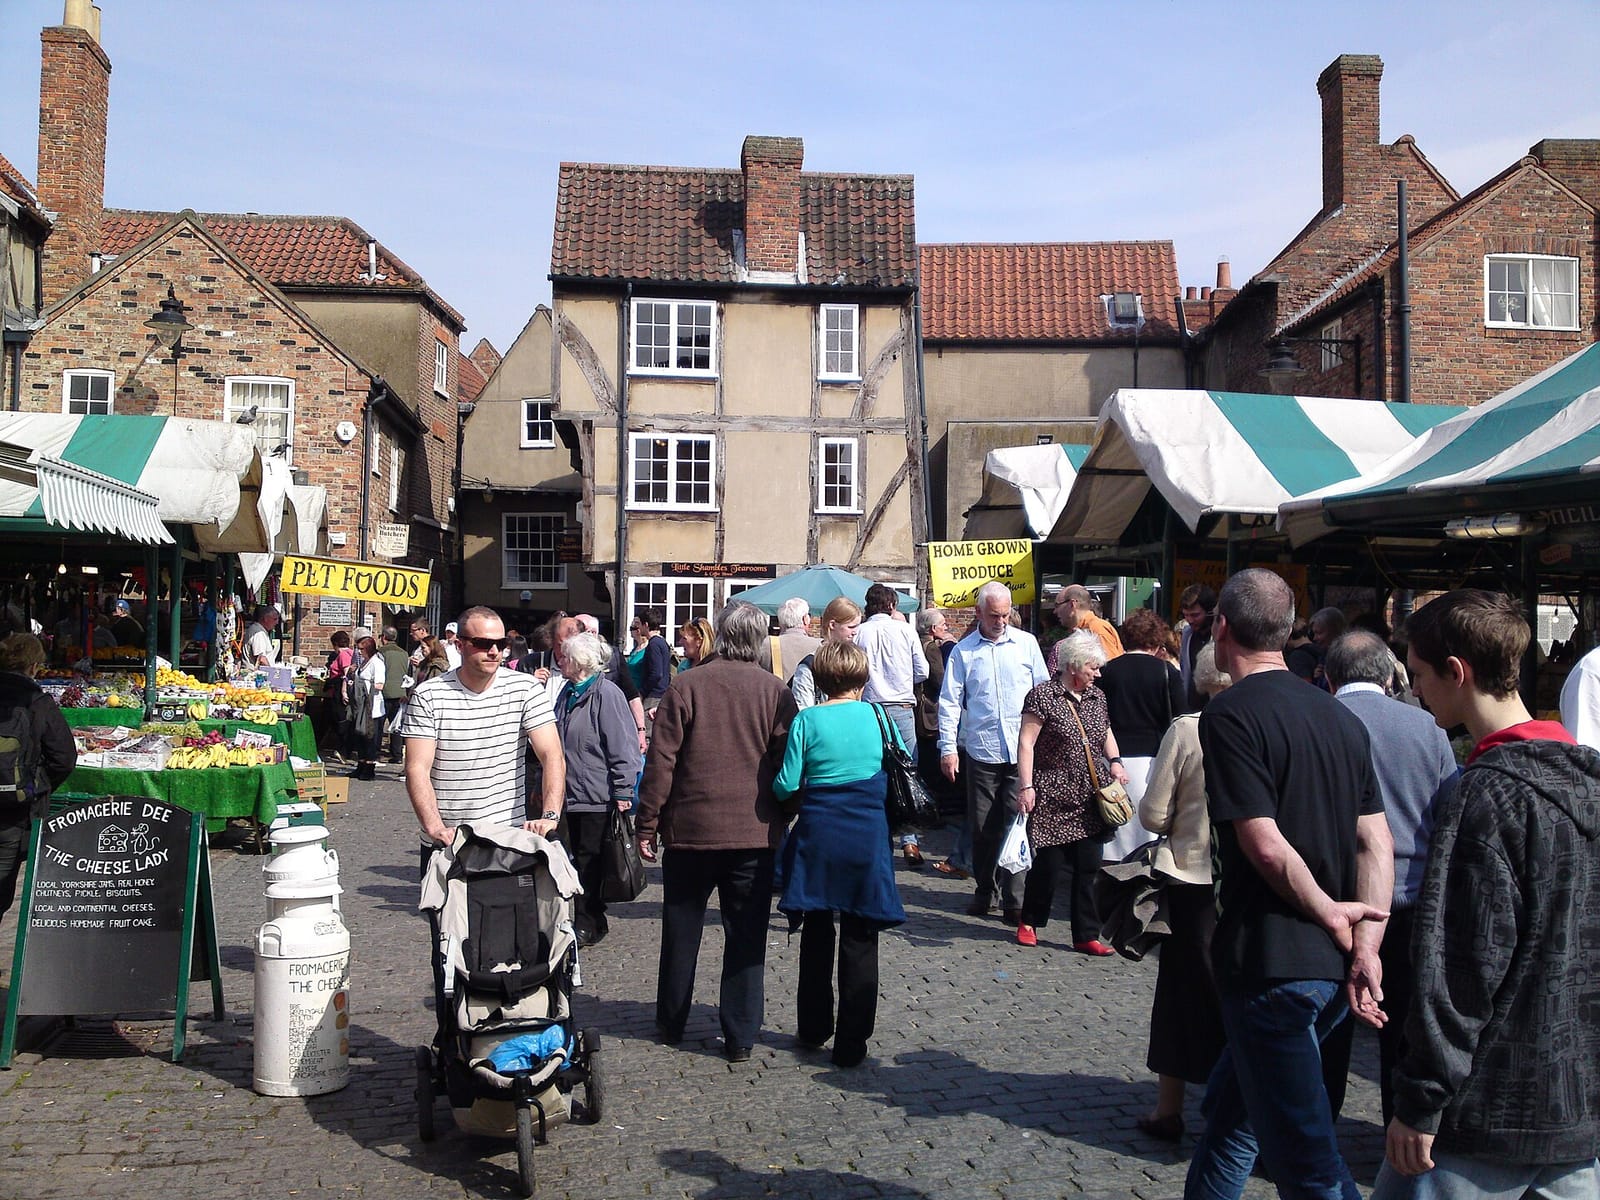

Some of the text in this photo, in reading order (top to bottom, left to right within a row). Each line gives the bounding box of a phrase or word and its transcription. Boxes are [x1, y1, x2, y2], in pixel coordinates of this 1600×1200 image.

[378, 524, 407, 533] Shambles
[379, 530, 405, 538] Butchers
[933, 540, 1028, 558] HOME GROWN
[671, 563, 768, 573] Little Shambles Tearooms
[952, 564, 1013, 579] PRODUCE
[289, 561, 420, 600] PET FOODS
[943, 591, 968, 606] Pick
[48, 801, 173, 833] FROMAGERIE DEE
[45, 844, 169, 875] THE CHEESE LADY
[36, 881, 58, 889] LOCAL
[60, 880, 97, 889] YORKSHIRE
[35, 904, 54, 912] LOCAL
[57, 904, 71, 912] AND
[122, 903, 156, 912] CHEESES.
[32, 918, 67, 928] DELICIOUS
[70, 919, 105, 928] HOMEMADE
[109, 919, 131, 928] FRUIT
[289, 980, 313, 993] THE
